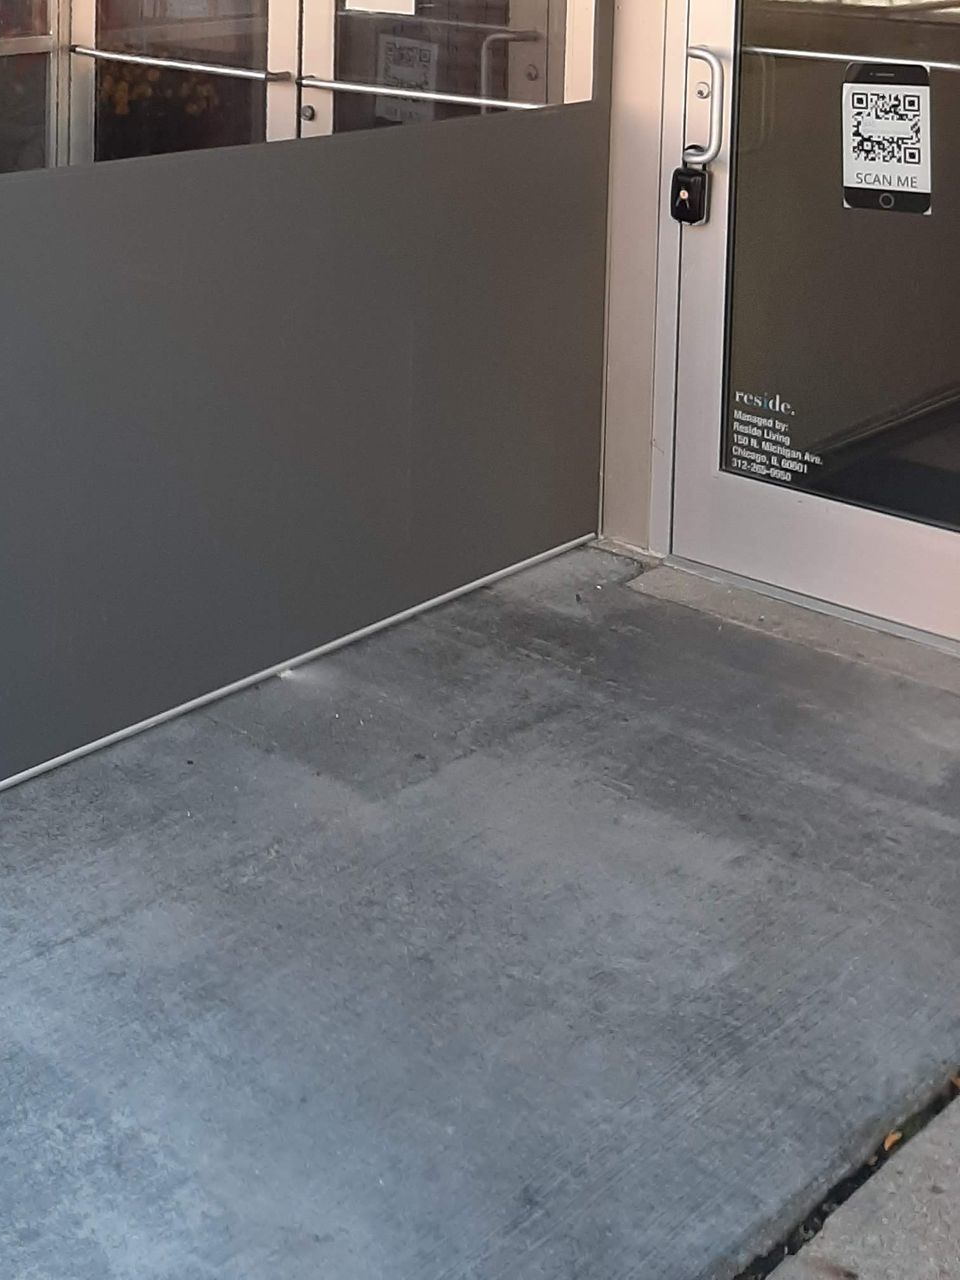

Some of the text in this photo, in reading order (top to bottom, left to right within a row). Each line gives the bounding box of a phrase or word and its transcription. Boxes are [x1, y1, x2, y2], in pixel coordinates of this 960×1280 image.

[855, 172, 918, 188] SCAN ME
[733, 409, 789, 432] Managed by:
[733, 421, 791, 446] Reside Living
[732, 445, 769, 465] Chicago,
[762, 441, 802, 460] Michigan
